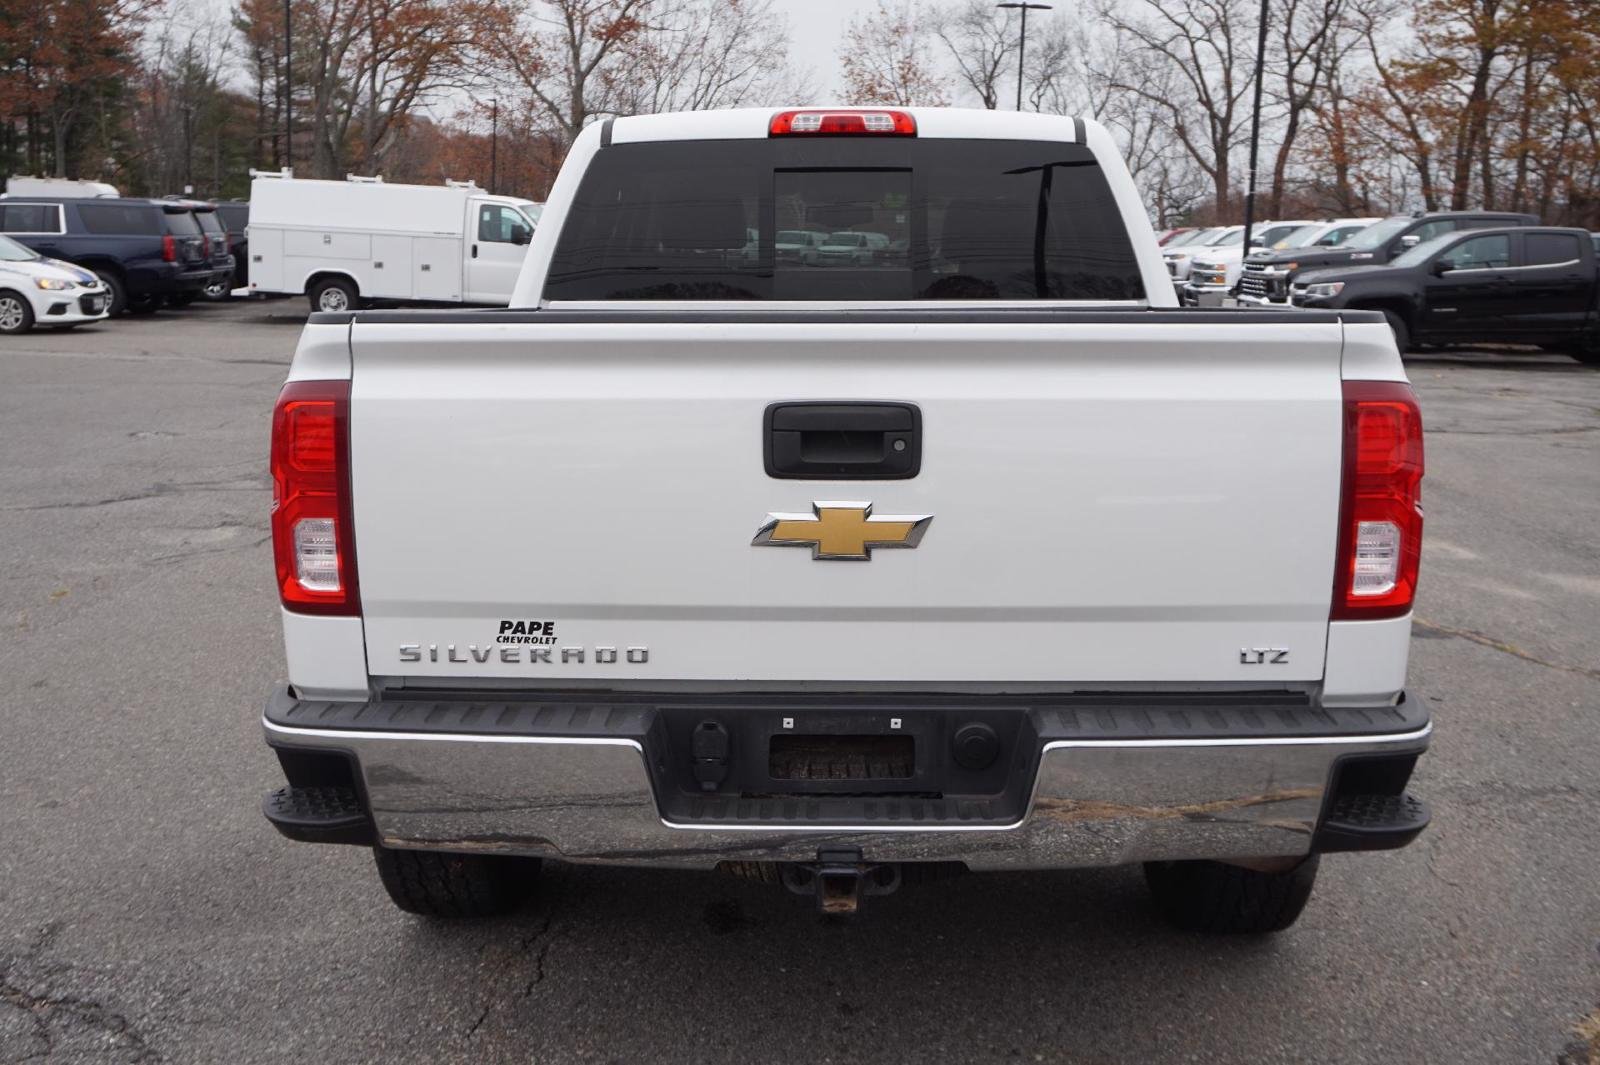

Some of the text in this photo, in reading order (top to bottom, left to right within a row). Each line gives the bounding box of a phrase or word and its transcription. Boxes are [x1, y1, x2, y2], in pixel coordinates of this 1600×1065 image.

[499, 620, 555, 636] PAPE
[496, 635, 558, 645] CHEVROLET
[398, 644, 649, 664] SILVERADO
[1240, 647, 1289, 664] LTZ
